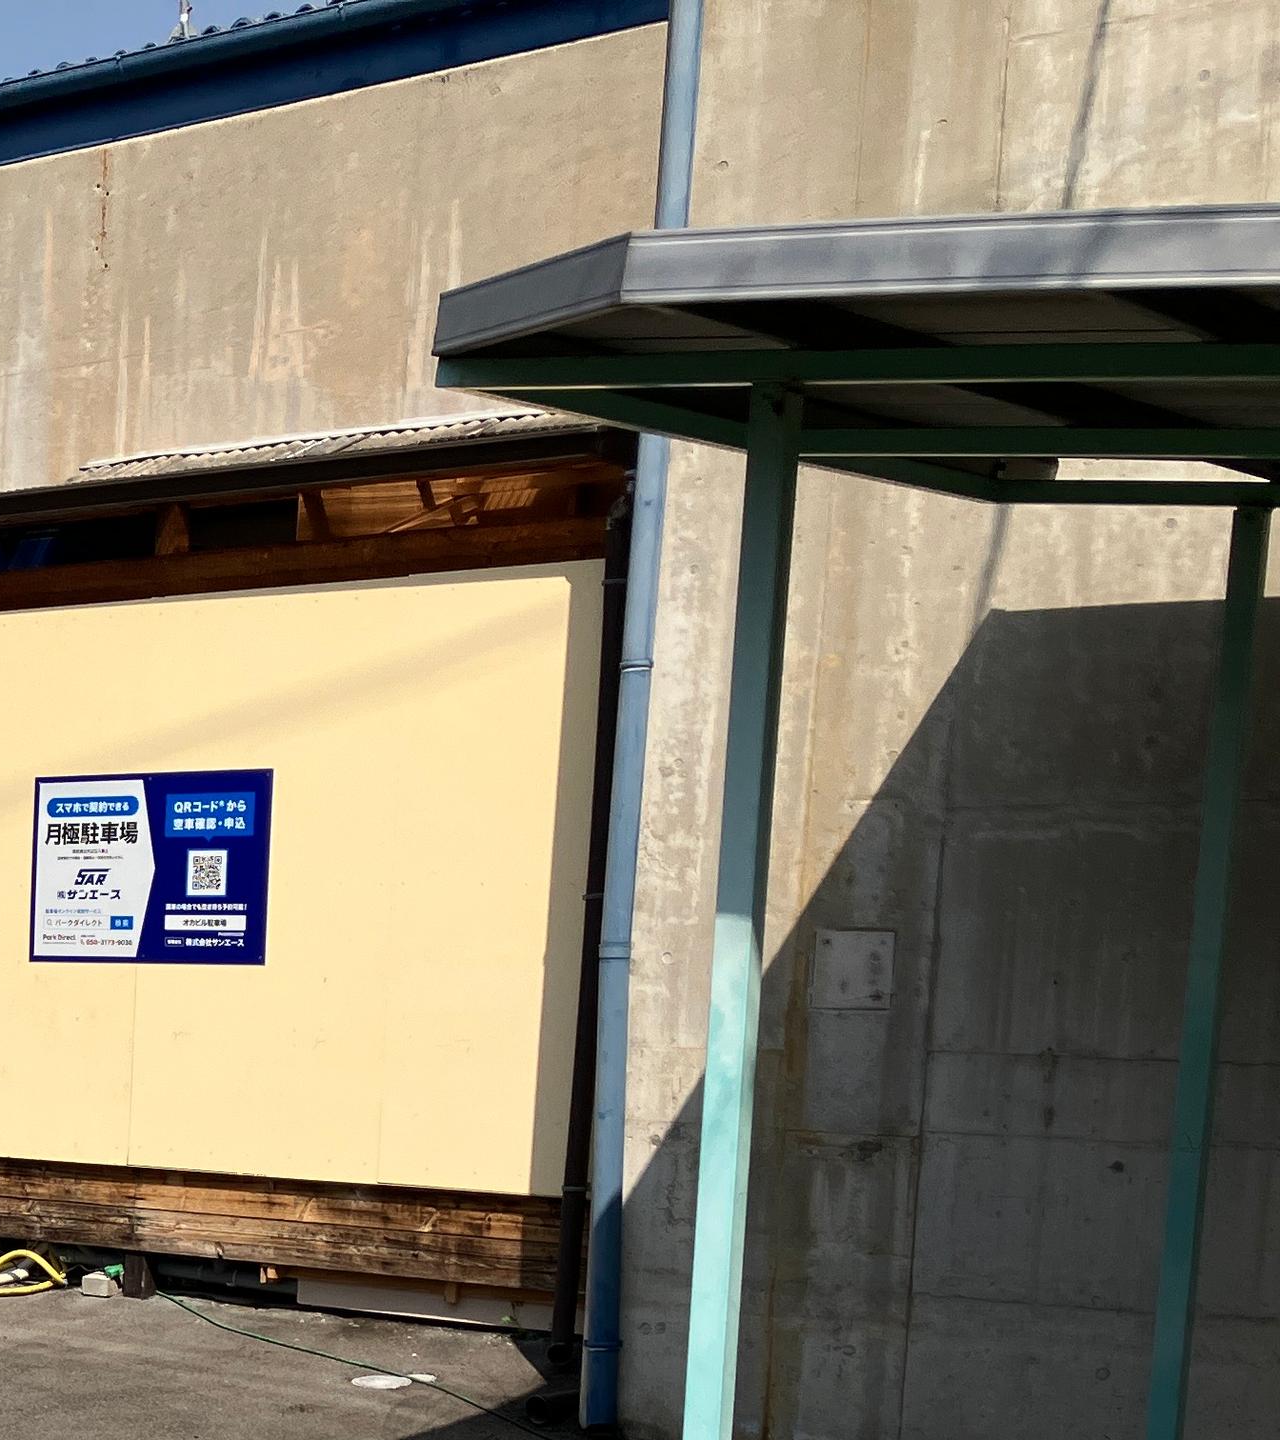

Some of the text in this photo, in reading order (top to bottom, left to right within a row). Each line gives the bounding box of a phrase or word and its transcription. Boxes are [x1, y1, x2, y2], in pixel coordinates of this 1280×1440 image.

[55, 801, 130, 814] スマホで契約できる
[173, 817, 246, 831] 空車確認・申込
[45, 821, 139, 846] 月極駐車場
[54, 918, 103, 927] パークダイレクト
[185, 938, 245, 948] 株式会社サンエース
